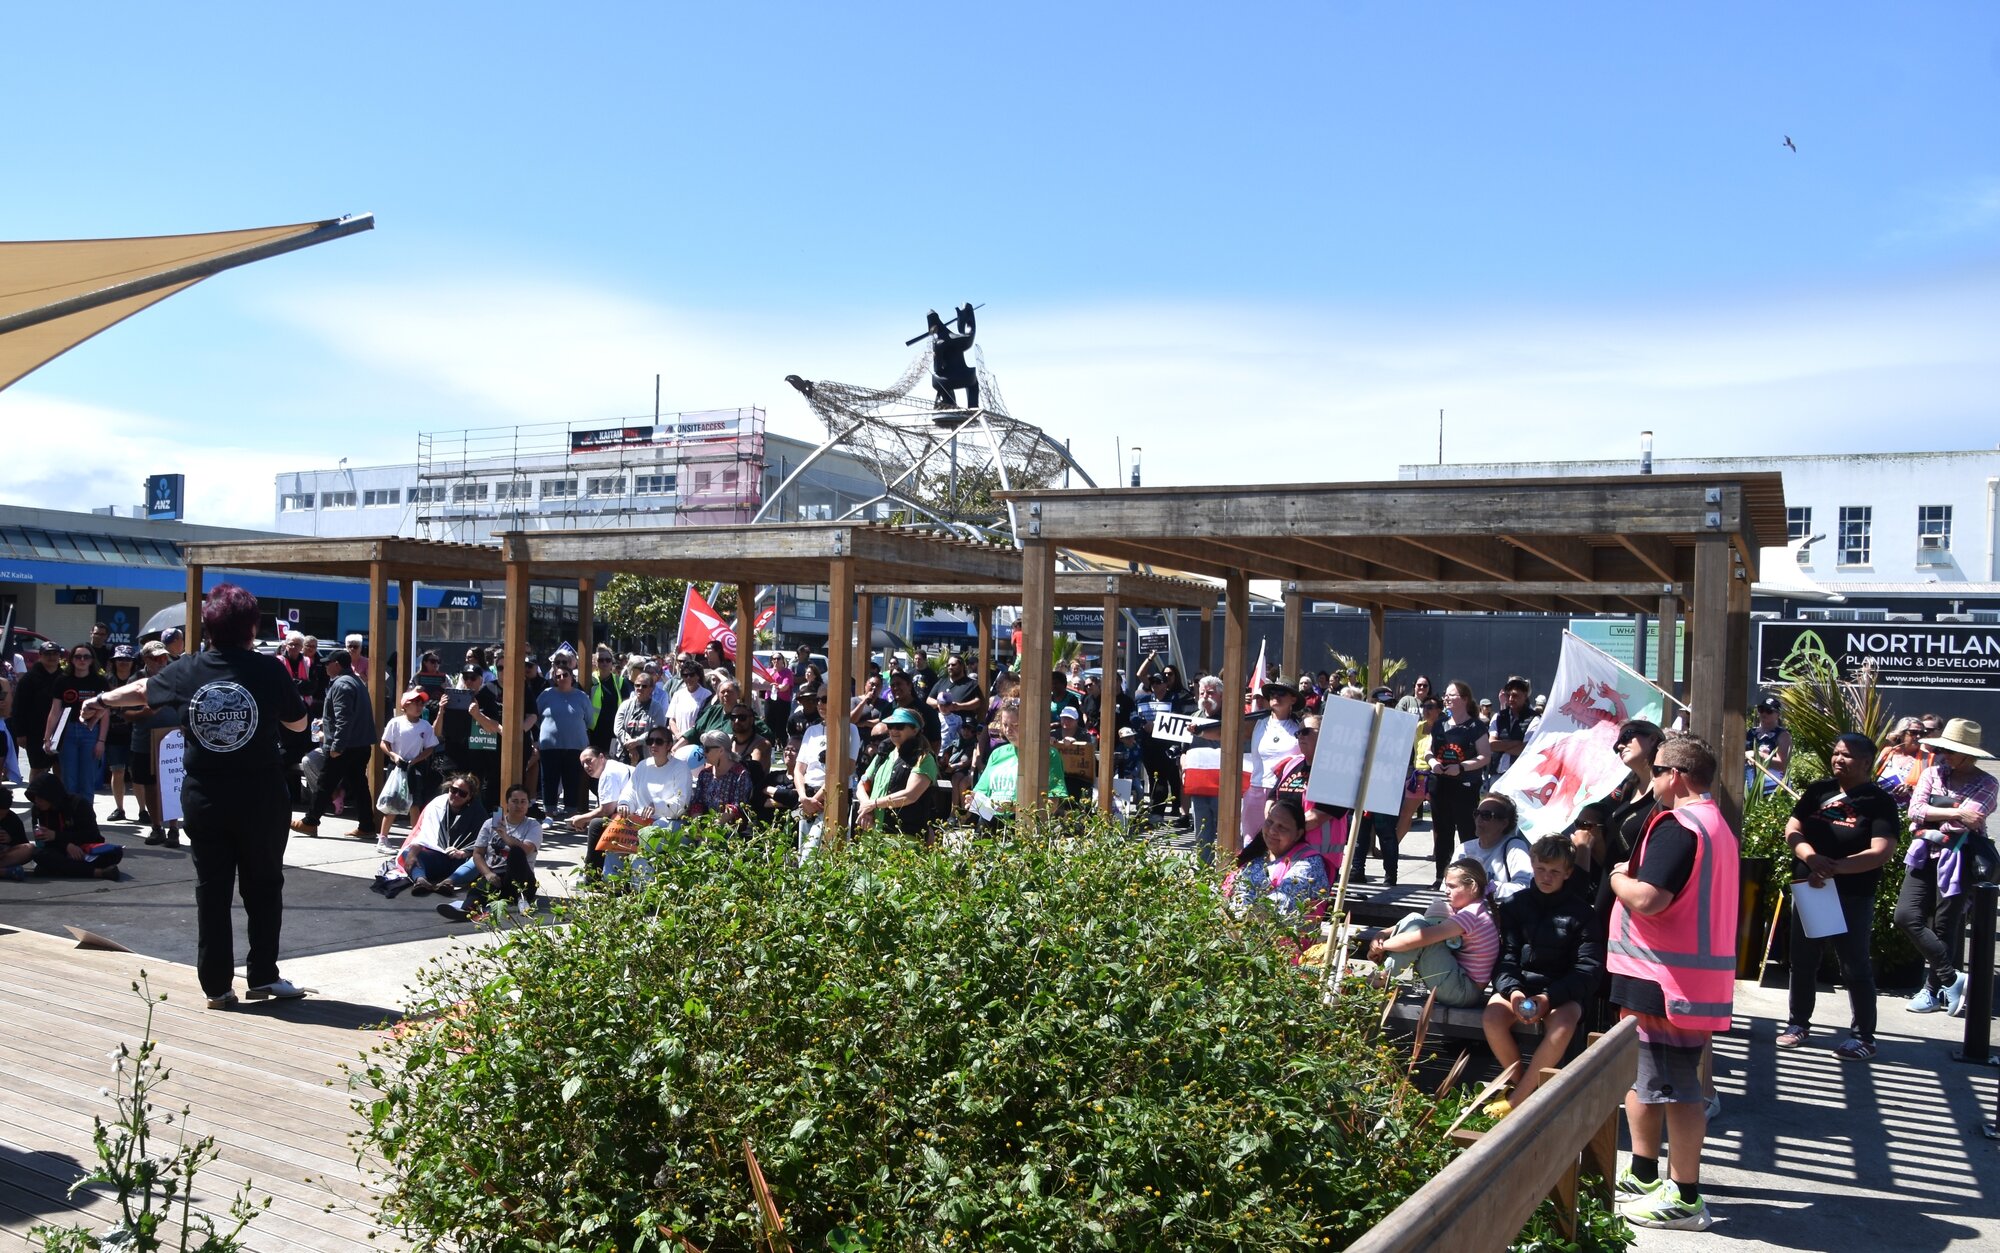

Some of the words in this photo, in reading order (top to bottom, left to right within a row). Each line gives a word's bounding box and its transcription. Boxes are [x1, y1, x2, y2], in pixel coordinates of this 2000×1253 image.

[154, 499, 171, 510] ANZ
[11, 572, 33, 580] Kaitaia
[451, 596, 469, 606] ANZ
[106, 633, 131, 643] ANZ
[1846, 655, 1913, 667] PLANNING
[1915, 657, 1925, 667] &
[1885, 675, 1986, 685] www.northplanner.co.nz
[197, 710, 247, 722] PANGURU
[1158, 715, 1193, 737] WTF
[161, 757, 178, 765] need
